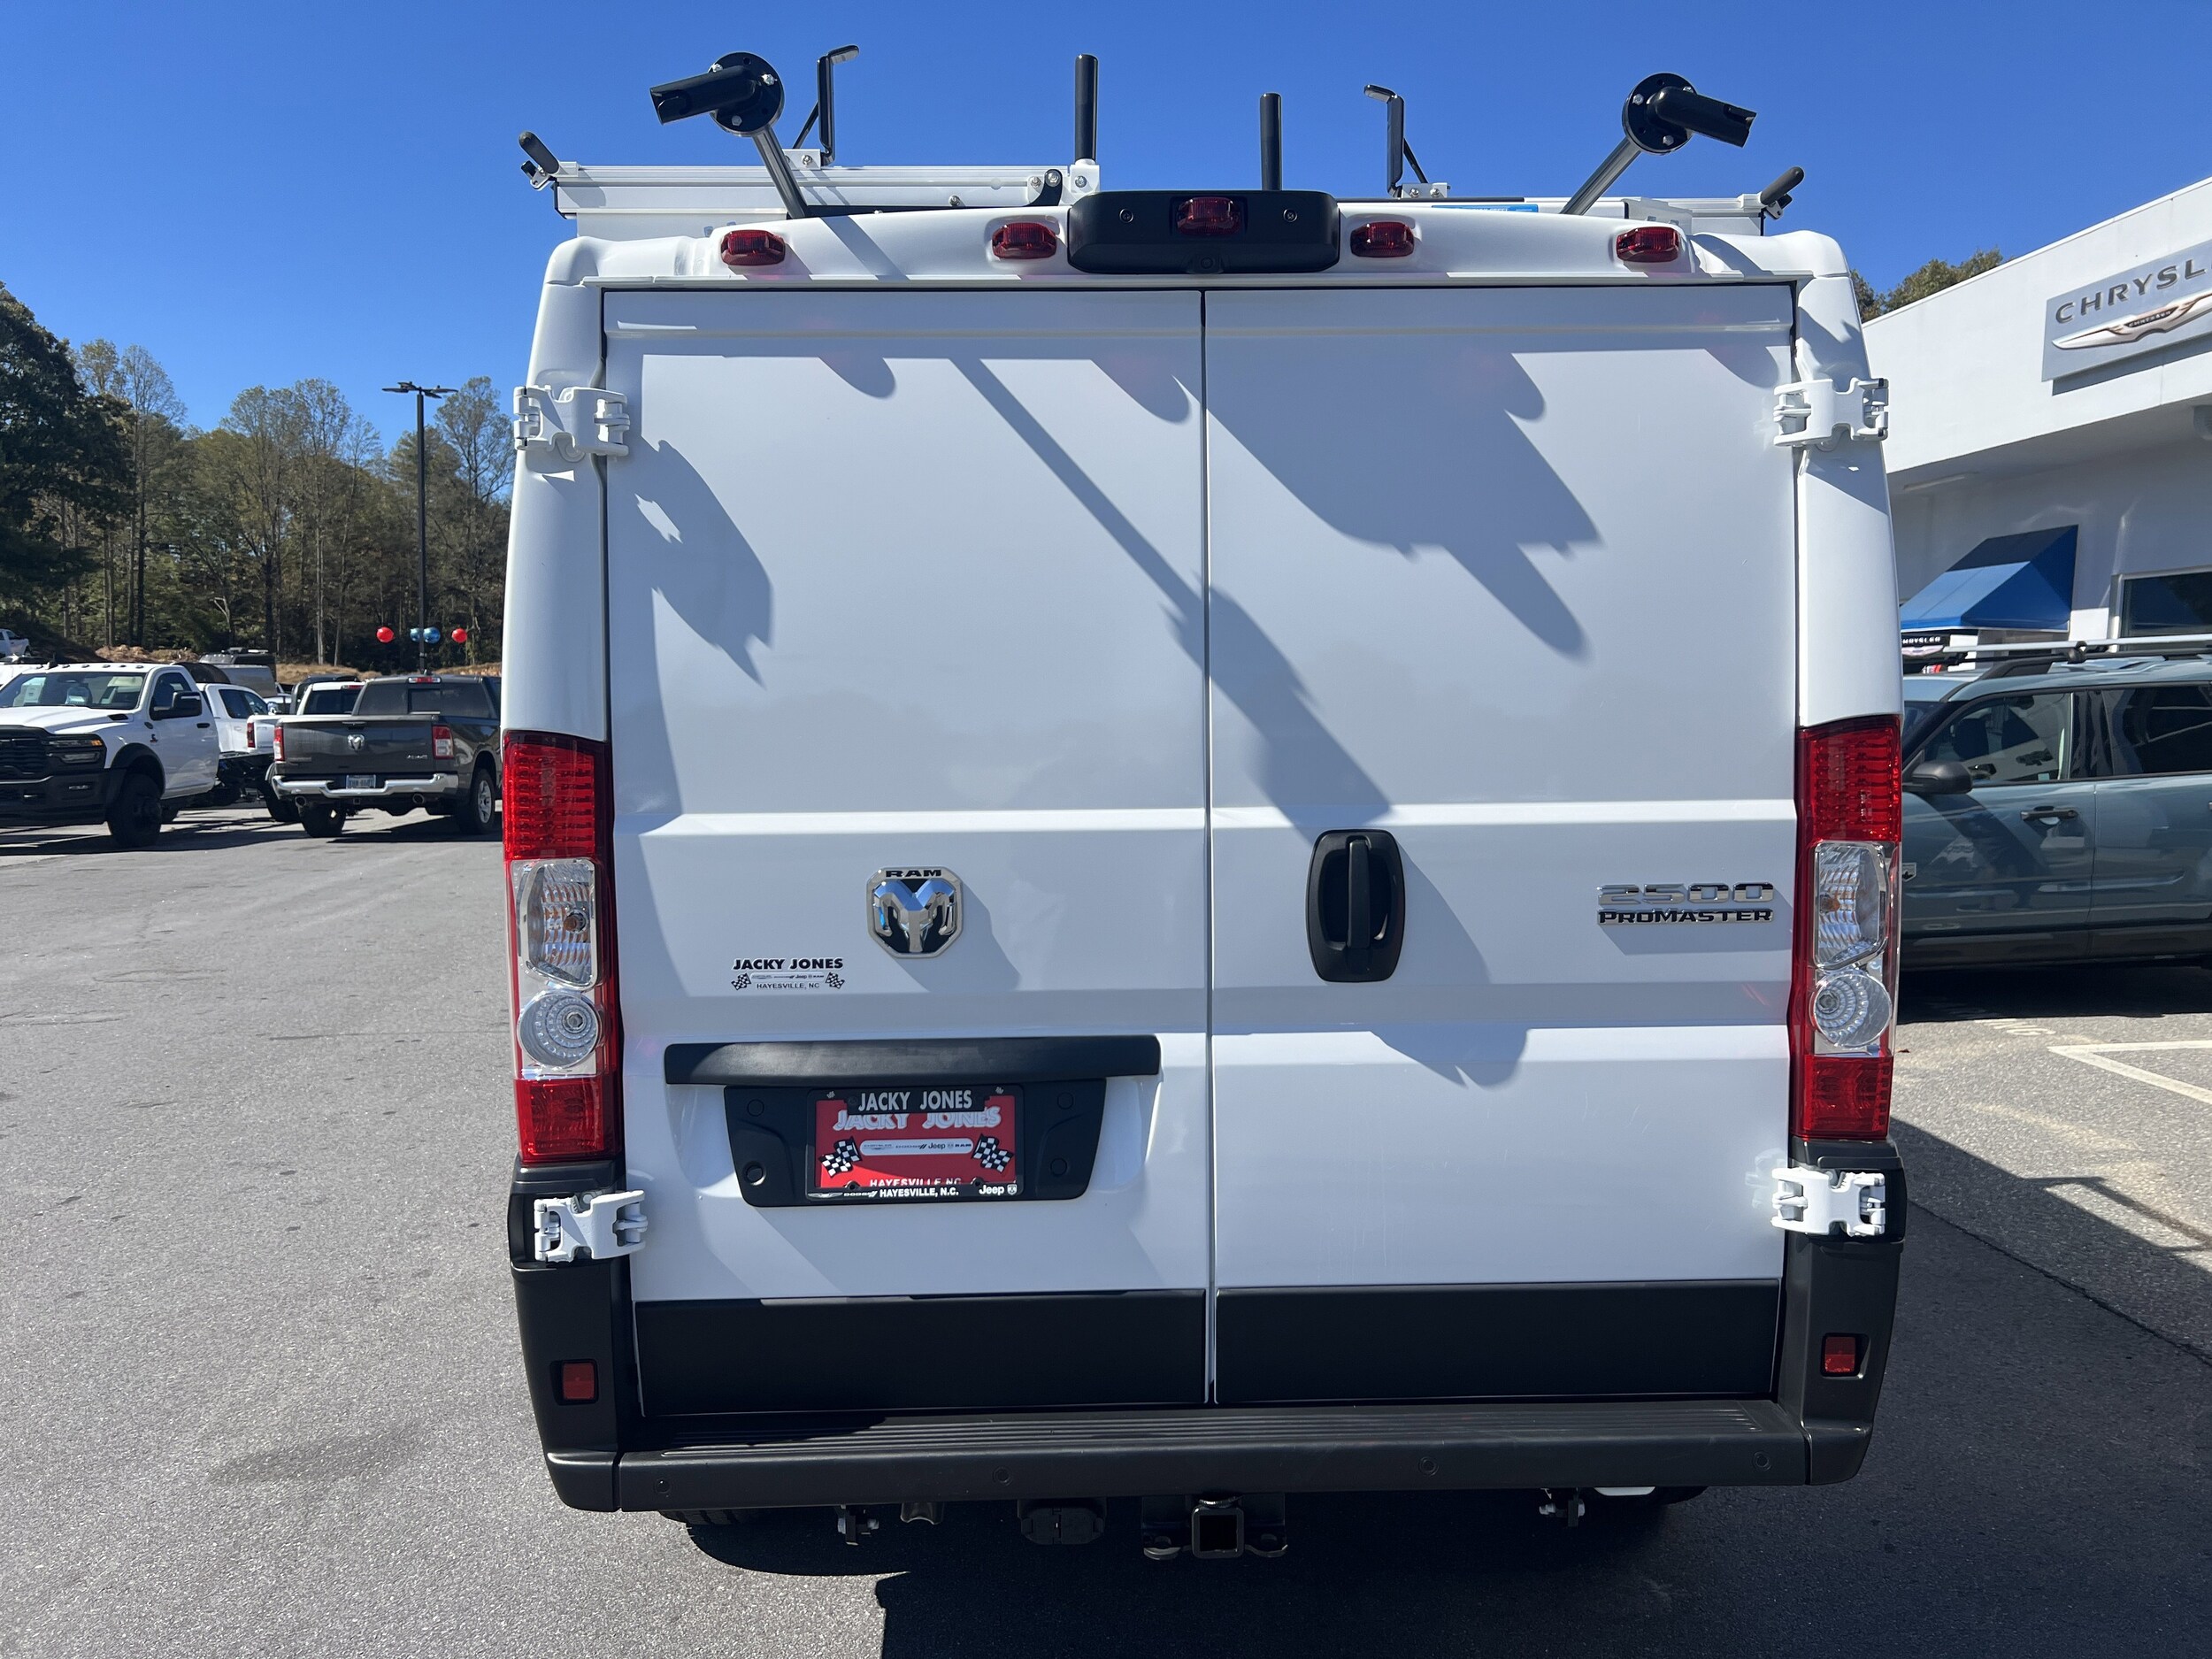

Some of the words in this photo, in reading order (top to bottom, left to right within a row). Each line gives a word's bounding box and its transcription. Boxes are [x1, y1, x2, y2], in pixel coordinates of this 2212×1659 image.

[2055, 258, 2212, 324] CHRYSL
[1598, 883, 1774, 905] 2500
[733, 958, 785, 970] JACKY
[789, 957, 843, 969] JONES
[858, 1092, 910, 1111] JACKY
[920, 1090, 972, 1110] JONES
[833, 1110, 910, 1131] JACKY
[922, 1106, 1002, 1129] JONES
[879, 1187, 938, 1198] HAYESVILLE,
[940, 1187, 959, 1196] N.C.
[979, 1185, 1005, 1195] Jeep
